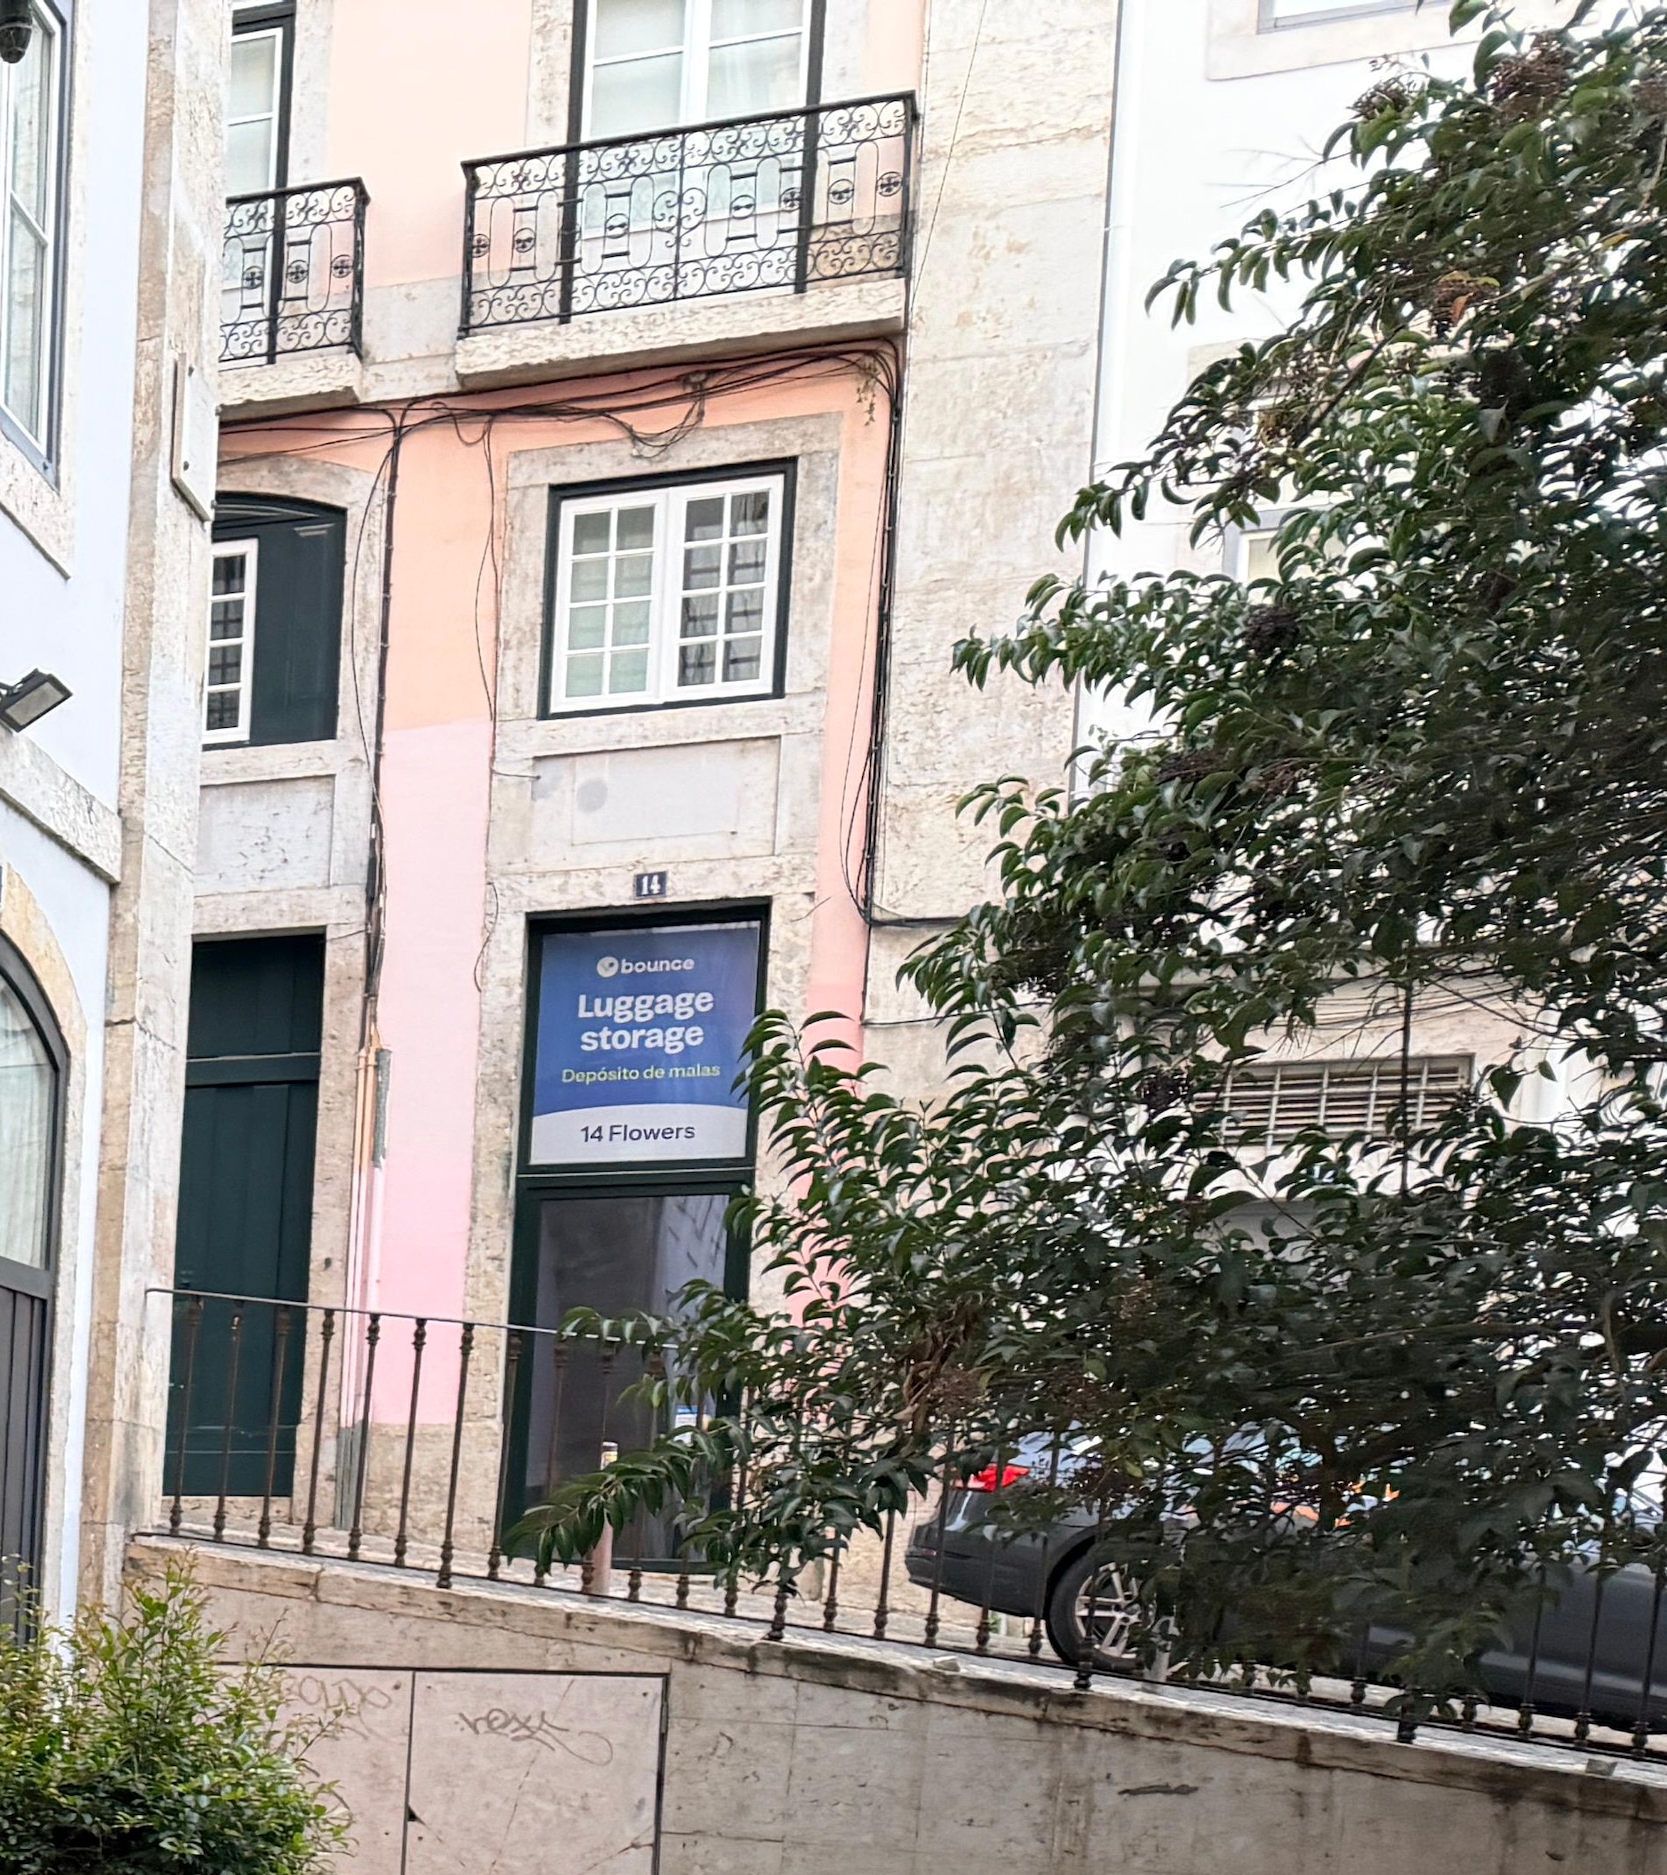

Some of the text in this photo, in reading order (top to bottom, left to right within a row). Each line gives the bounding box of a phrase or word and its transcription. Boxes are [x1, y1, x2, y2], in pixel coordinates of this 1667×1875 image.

[640, 874, 662, 895] 14
[620, 958, 695, 974] bounce
[578, 991, 714, 1024] Luggage
[580, 1025, 705, 1055] storage
[561, 1063, 721, 1085] Depósito de malas
[580, 1124, 696, 1143] 14 Flowers
